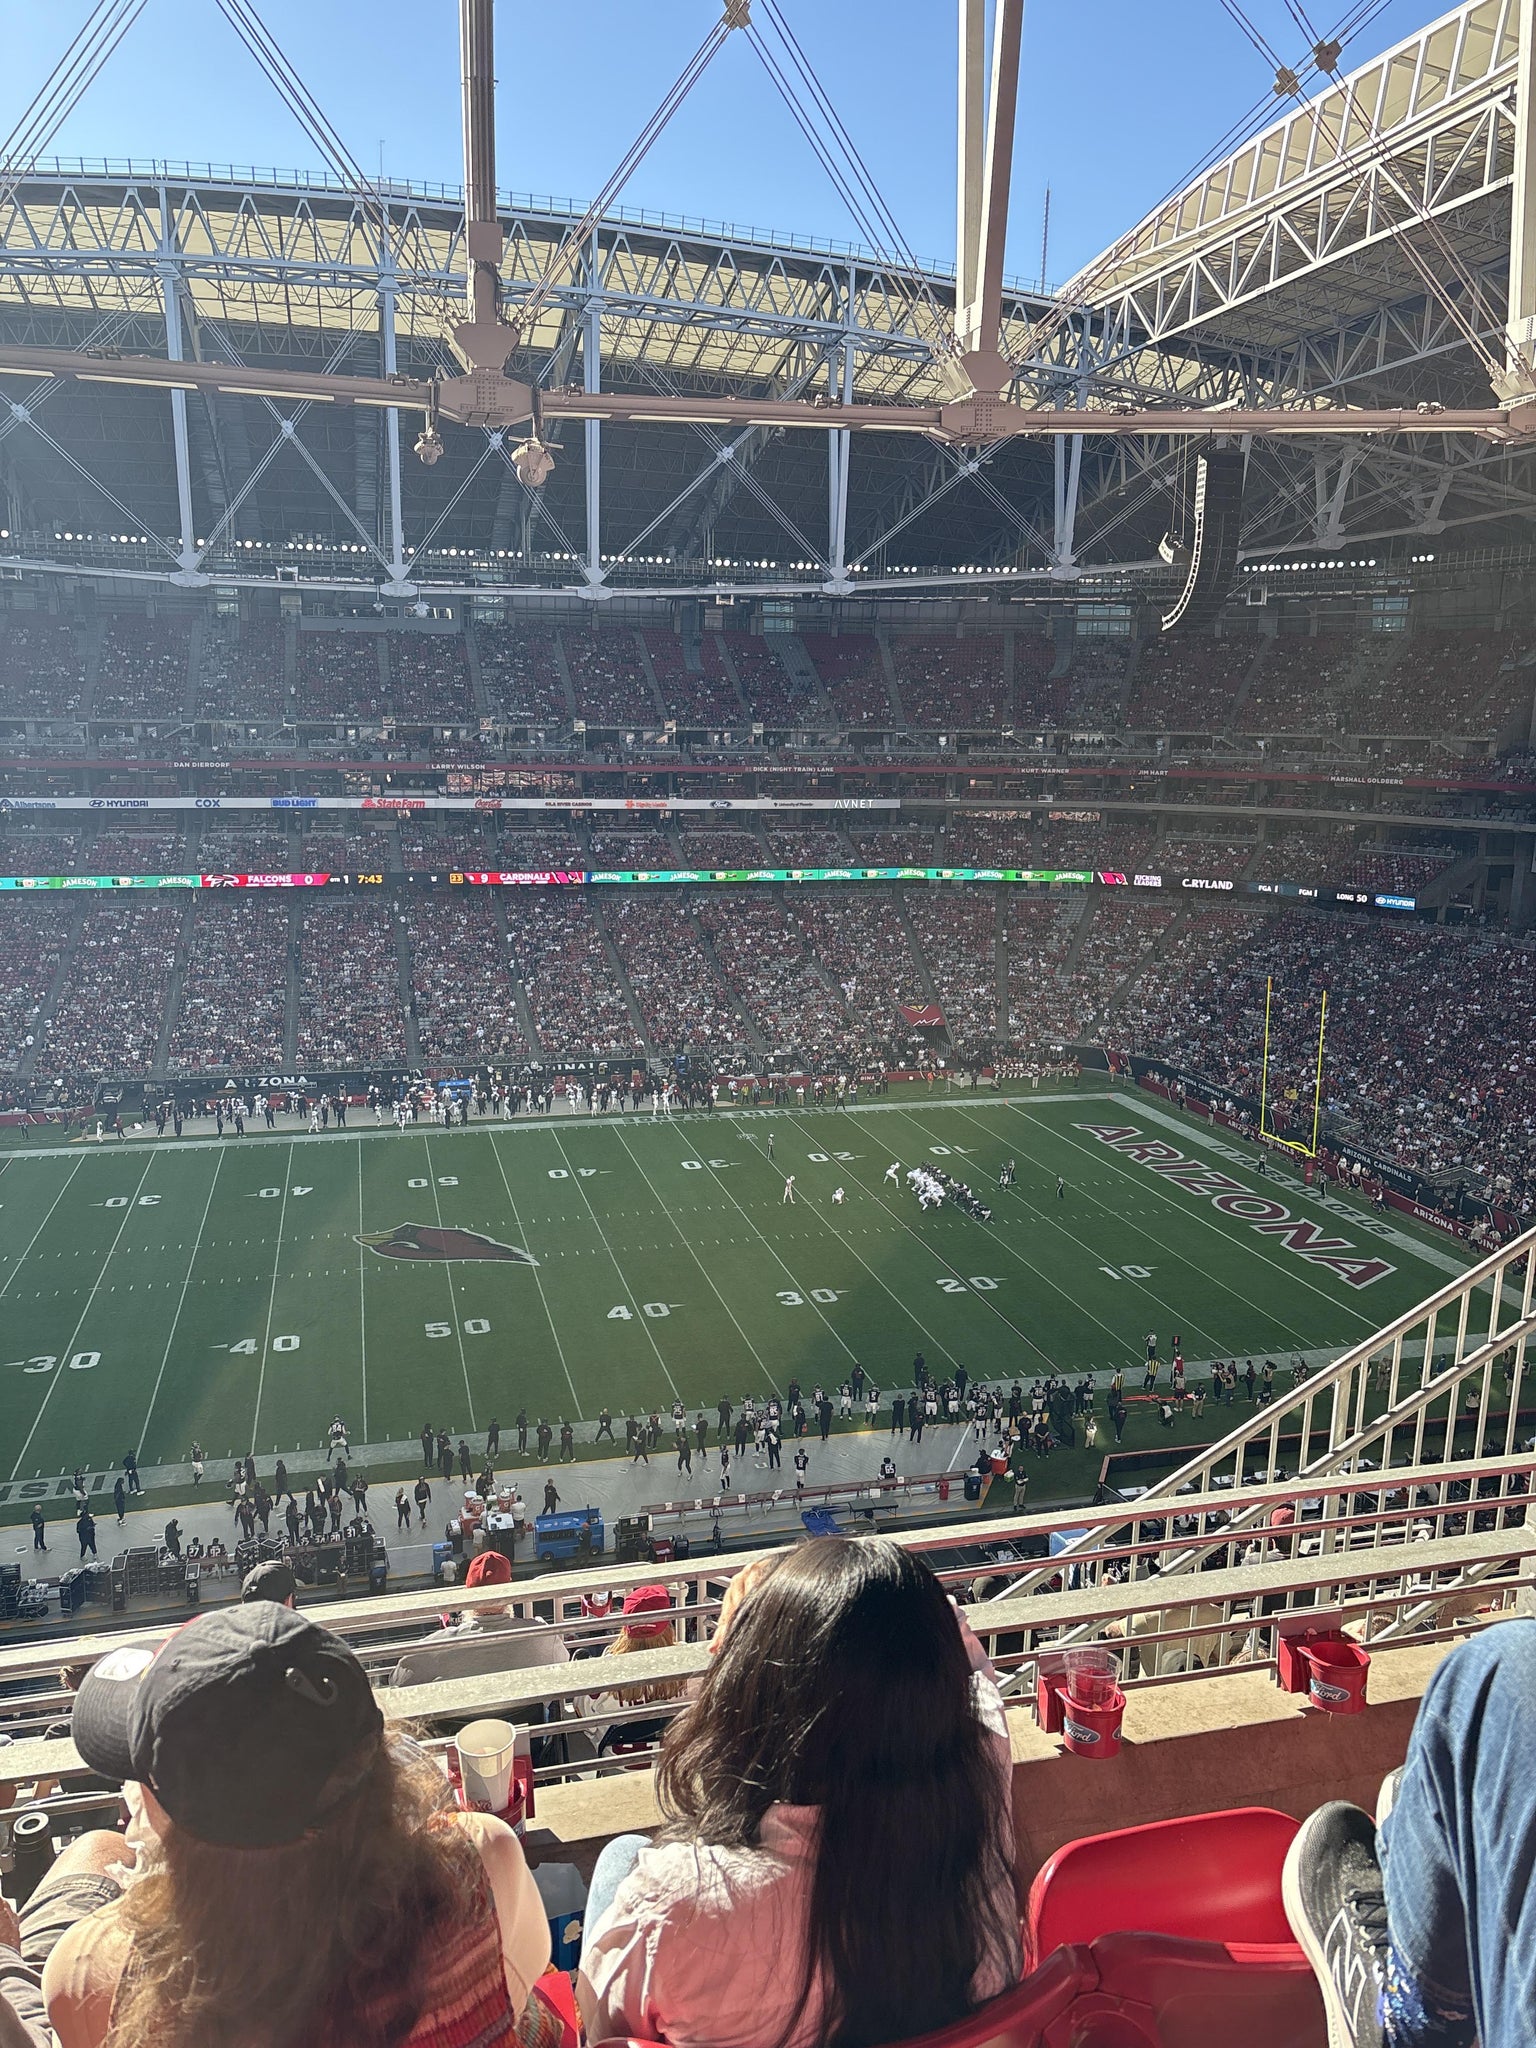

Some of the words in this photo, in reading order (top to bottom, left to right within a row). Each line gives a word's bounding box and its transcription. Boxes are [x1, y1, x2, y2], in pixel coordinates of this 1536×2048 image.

[1330, 775, 1366, 784] MARSHALL
[1367, 778, 1404, 786] GOLDBERG
[14, 800, 56, 808] Albertsons
[195, 799, 221, 807] COX
[272, 799, 290, 807] BUD
[291, 799, 317, 807] LIGHT
[376, 799, 401, 808] State
[401, 799, 425, 808] Farm
[480, 875, 488, 884] 9
[500, 873, 550, 882] CARDINALS
[591, 874, 621, 882] JAMESON
[670, 873, 699, 881] JAMESON
[746, 872, 776, 880] JAMESON
[823, 871, 852, 879] JAMESON
[896, 868, 926, 878] JAMESON
[974, 871, 1004, 880] JAMESON
[1055, 872, 1086, 882] JAMESON
[62, 878, 98, 887] JAMESON
[158, 877, 192, 887] JAMESON
[247, 876, 292, 884] FALCONS
[304, 875, 313, 885] 0
[357, 874, 383, 884] 7:43
[1298, 888, 1313, 896] FGM
[1336, 893, 1354, 901] LONG
[1356, 894, 1368, 903] 50
[1386, 898, 1416, 907] HYUNDAI
[807, 1151, 856, 1163] 20
[680, 1159, 730, 1170] 30
[1341, 1147, 1371, 1164] ARIZONA
[1373, 1161, 1413, 1184] CARDINALS
[547, 1167, 597, 1179] 40
[407, 1176, 459, 1188] 50
[258, 1186, 314, 1198] 40
[104, 1194, 162, 1208] 30
[1070, 1122, 1398, 1291] ARIZONA
[1325, 1203, 1363, 1217] OF
[1356, 1219, 1396, 1236] US
[1412, 1206, 1455, 1232] ARIZONA
[1099, 1265, 1151, 1280] 10
[935, 1276, 999, 1294] 20
[775, 1288, 839, 1306] 30
[607, 1302, 671, 1321] 40
[424, 1318, 492, 1339] 50
[229, 1334, 300, 1355] 40
[22, 1351, 102, 1373] 30
[332, 1424, 342, 1432] 84
[885, 1466, 894, 1474] 65
[346, 1528, 356, 1538] 31
[189, 1546, 200, 1557] 27
[1312, 1683, 1342, 1700] Ford
[1066, 1725, 1092, 1742] Ford
